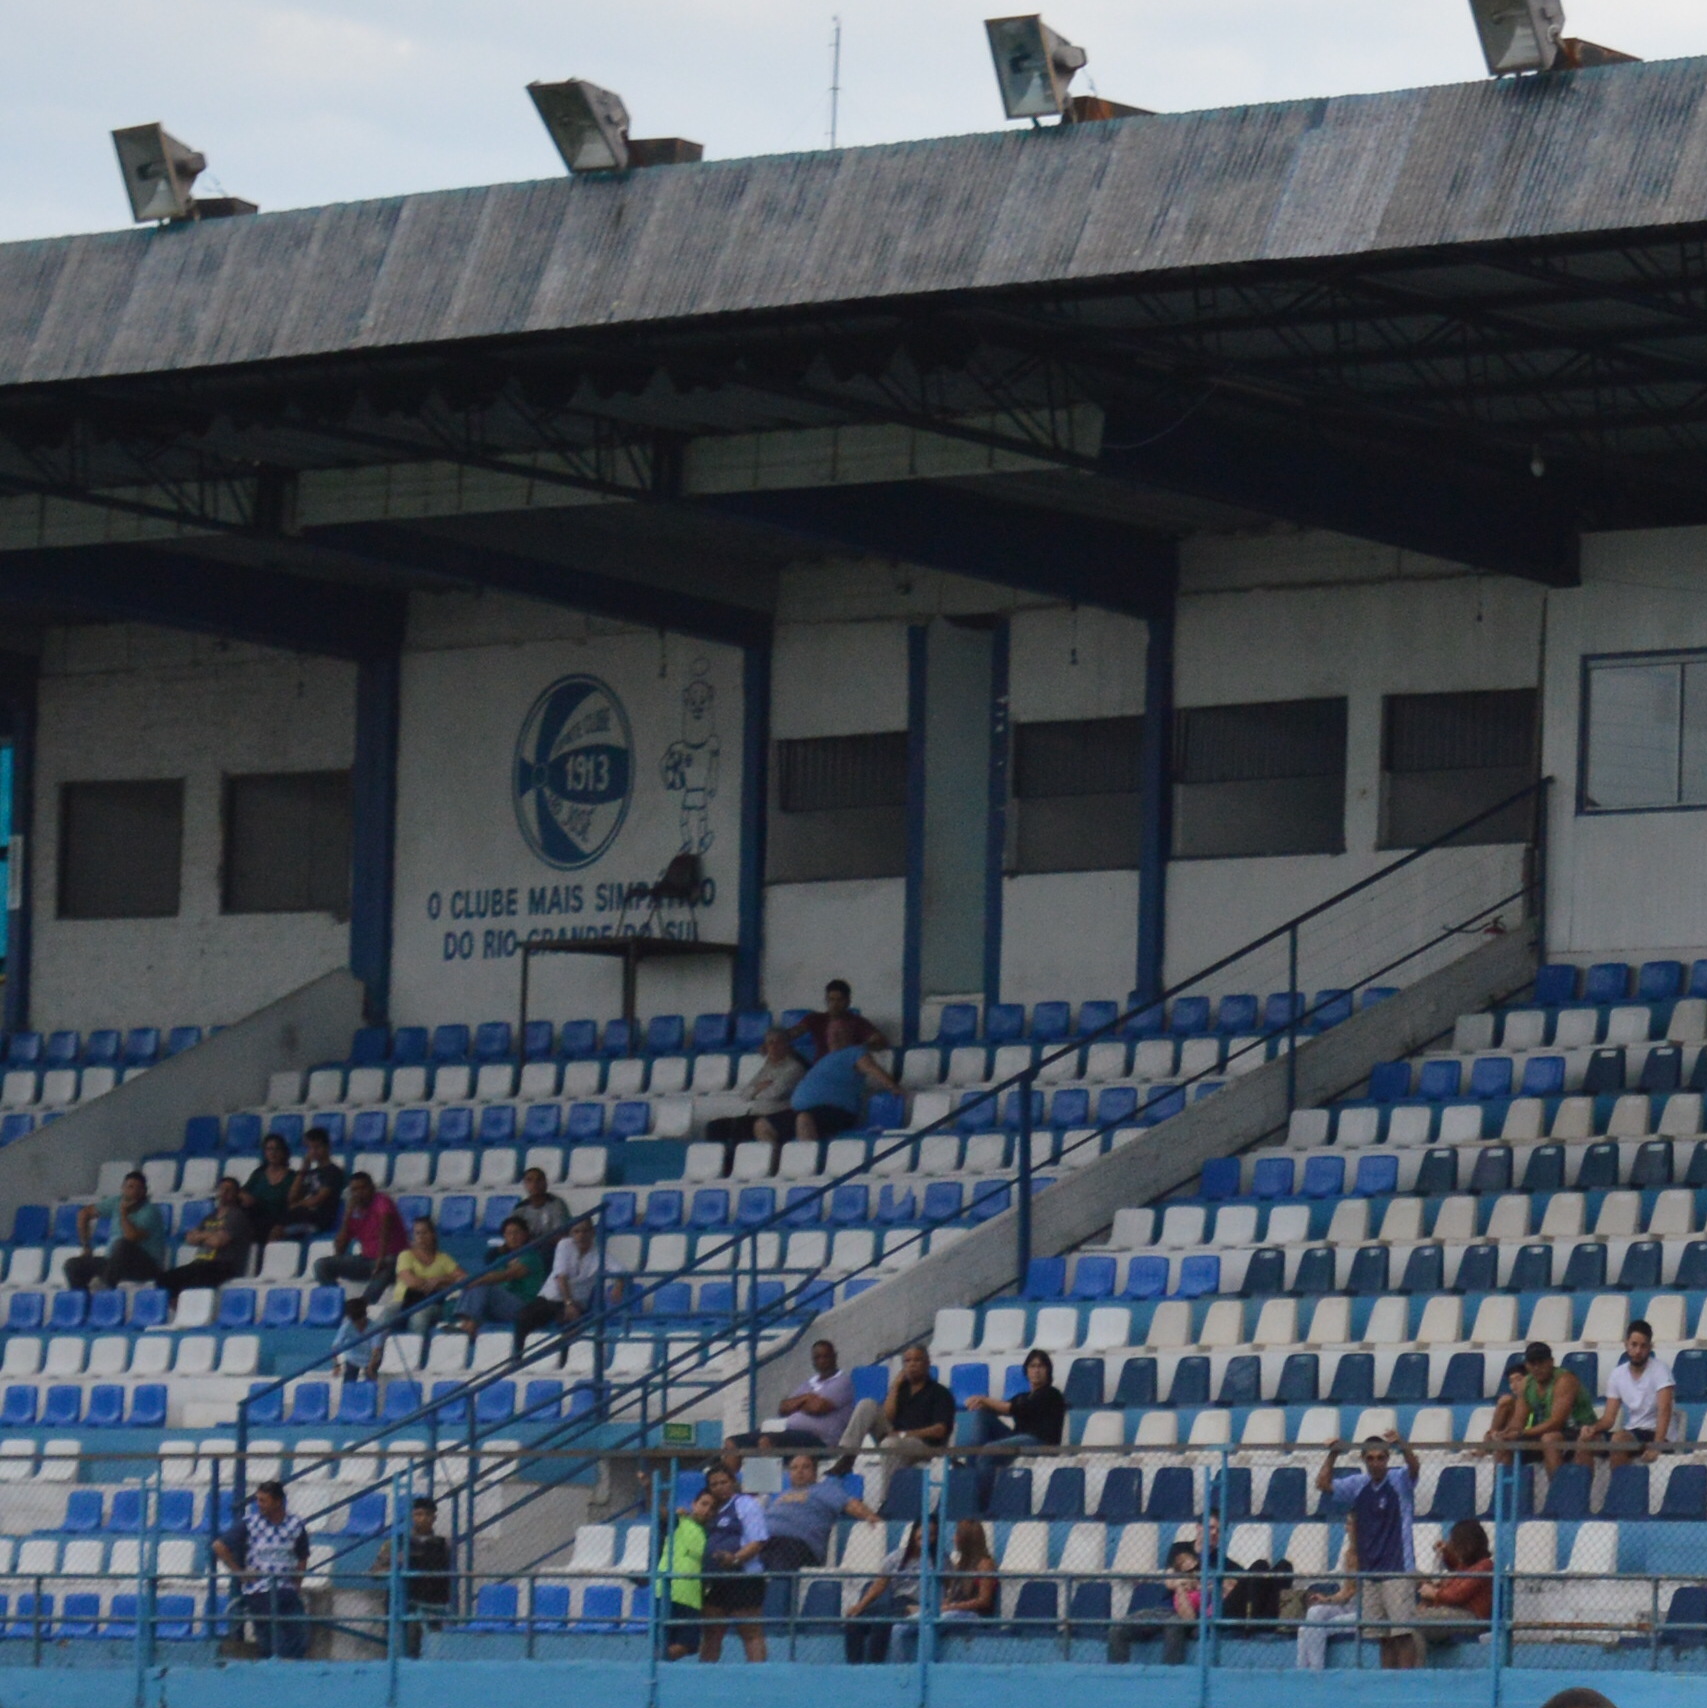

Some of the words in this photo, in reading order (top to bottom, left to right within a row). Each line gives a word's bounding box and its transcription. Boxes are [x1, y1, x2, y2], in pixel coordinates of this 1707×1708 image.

[566, 753, 609, 791] 1913
[427, 891, 442, 920] O
[450, 887, 518, 919] CLUBE
[527, 883, 584, 915] MAIS
[443, 930, 475, 961] DO
[483, 928, 518, 958] RIO
